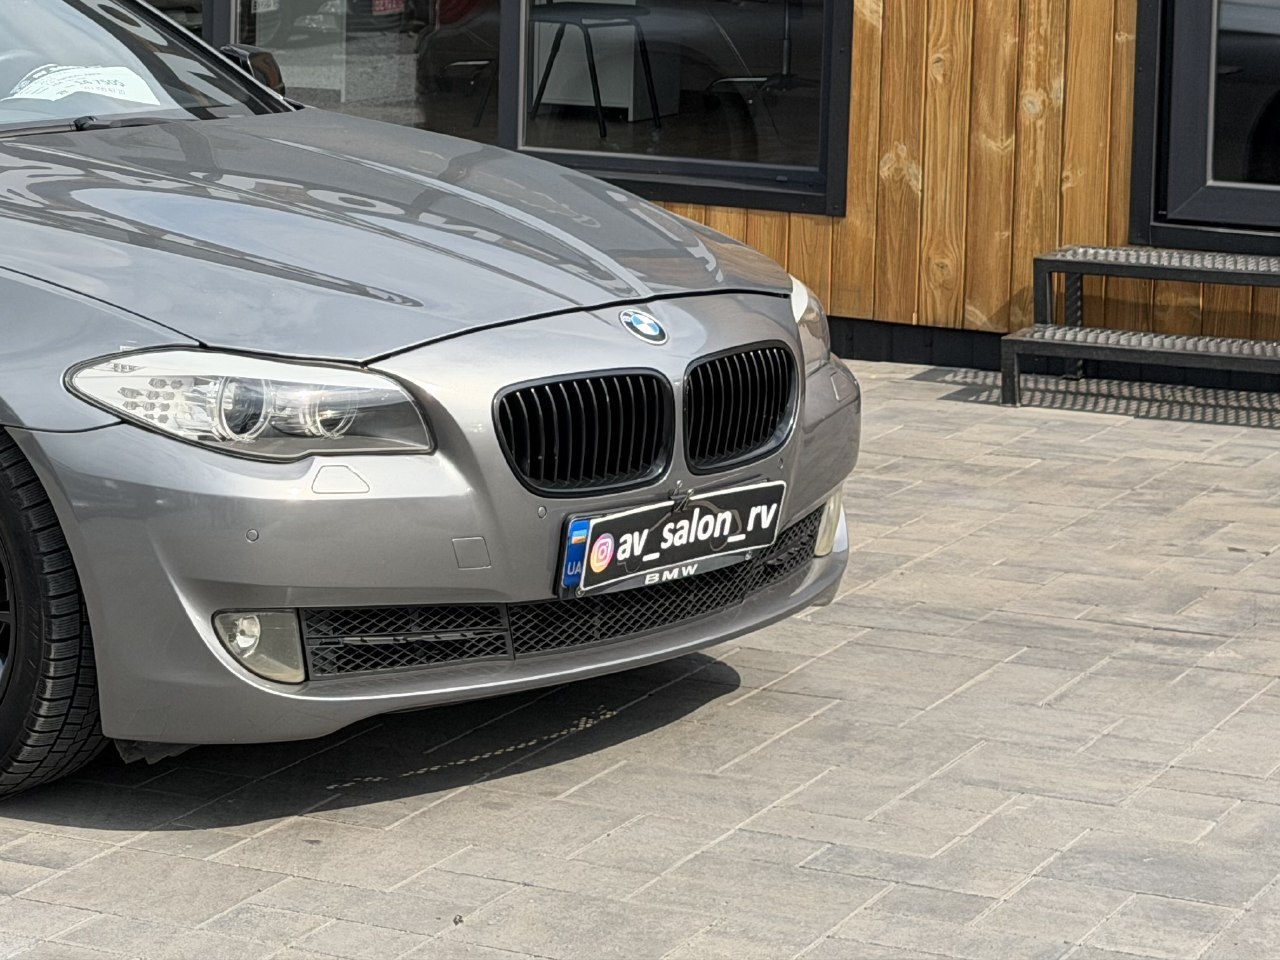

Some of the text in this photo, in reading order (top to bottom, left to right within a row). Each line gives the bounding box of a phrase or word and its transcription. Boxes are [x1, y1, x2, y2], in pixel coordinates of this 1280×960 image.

[616, 503, 778, 561] av_salon_rv
[567, 560, 582, 575] UA
[644, 563, 699, 585] BMW
